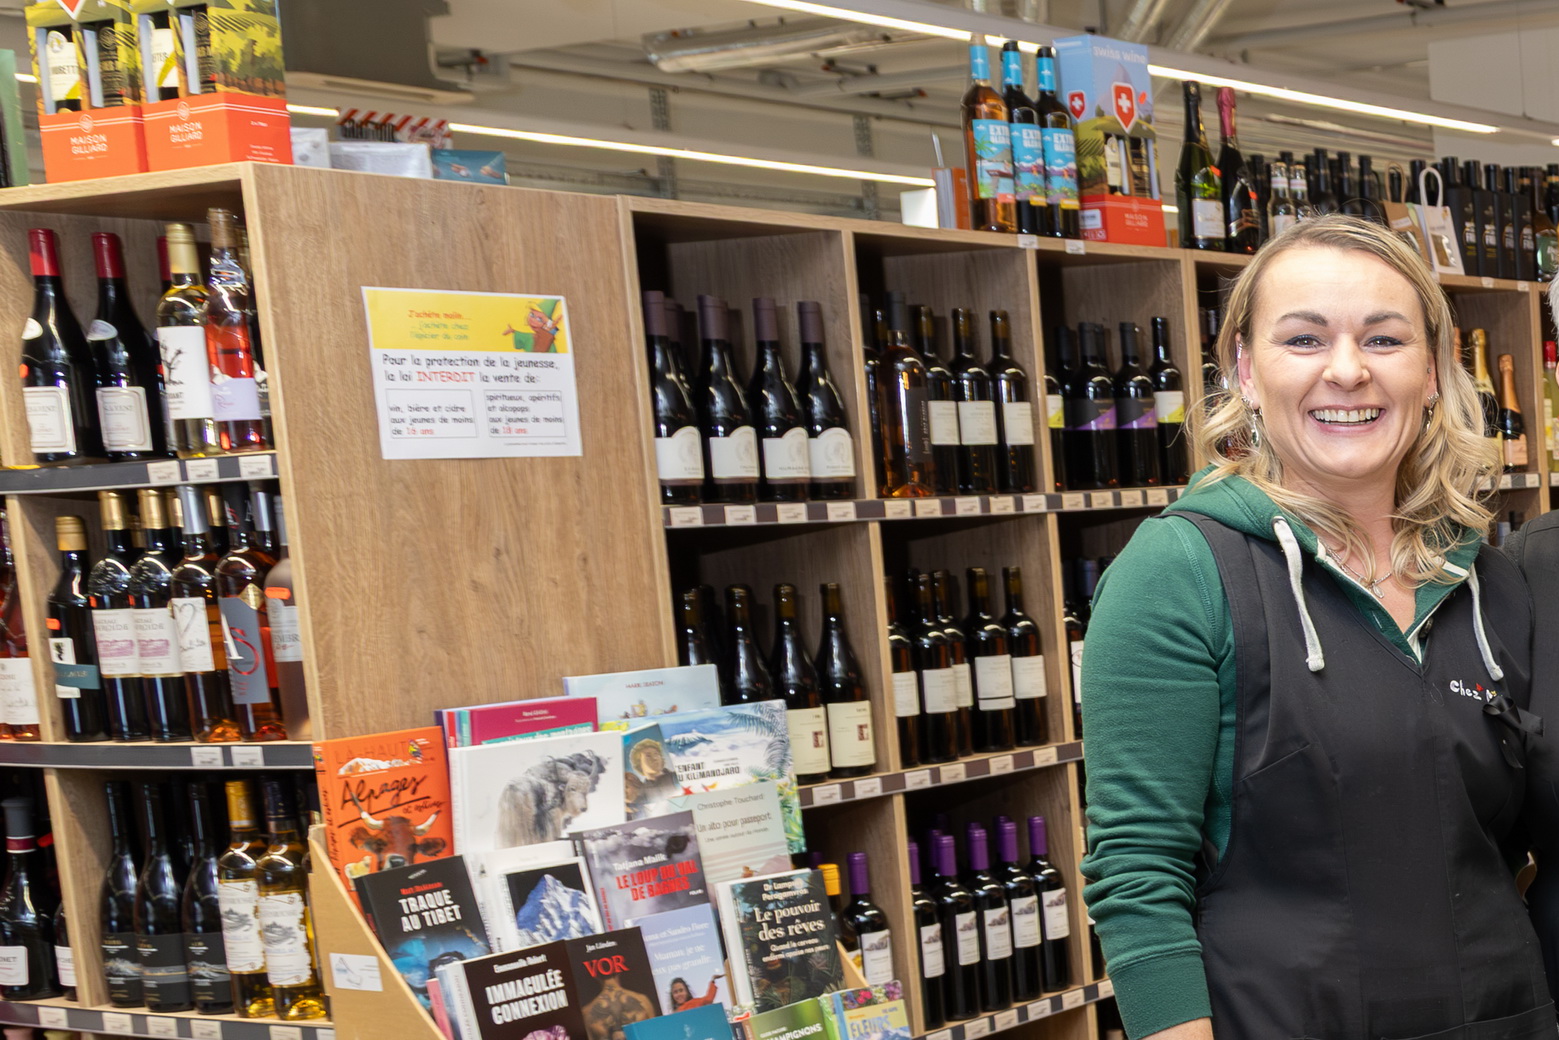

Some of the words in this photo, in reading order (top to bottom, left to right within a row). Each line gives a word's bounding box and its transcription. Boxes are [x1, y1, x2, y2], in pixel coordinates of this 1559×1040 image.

[1093, 45, 1120, 59] swiss
[1122, 50, 1145, 63] wine
[169, 121, 202, 133] MAISON
[70, 134, 107, 146] MAISON
[170, 131, 202, 143] GILLIARD
[71, 143, 108, 154] GILLIARD
[382, 354, 407, 366] Pour
[411, 354, 422, 366] la
[426, 355, 480, 369] protection
[483, 356, 496, 367] de
[500, 356, 510, 367] la
[514, 357, 560, 371] jeunesse,
[385, 370, 394, 381] la
[399, 370, 412, 381] loi
[416, 371, 475, 383] INTERDIT
[480, 371, 489, 382] la
[493, 372, 520, 384] vente
[389, 405, 403, 413] vin,
[407, 404, 430, 412] bière
[446, 404, 465, 413] cidre
[409, 416, 435, 426] jeunes
[439, 416, 448, 424] de
[452, 416, 473, 424] moins
[504, 416, 528, 426] jeunes
[543, 416, 563, 424] moins
[392, 427, 402, 435] de
[1450, 680, 1482, 700] Chez
[341, 774, 428, 814] Alpages
[697, 799, 732, 811] Christophe
[734, 793, 764, 804] Touchard
[697, 824, 707, 832] Un
[723, 819, 738, 830] pour
[741, 812, 772, 826] passeport
[613, 856, 643, 872] Tatjana
[643, 853, 667, 868] Malik
[616, 875, 629, 889] LE
[630, 869, 658, 886] LOUP
[659, 866, 675, 880] DU
[676, 860, 698, 876] VAL
[630, 886, 645, 901] DE
[647, 877, 690, 898] BAGNES
[762, 888, 809, 901] Perogamvros
[398, 889, 454, 915] TRAQUE
[401, 915, 422, 932] AU
[423, 905, 462, 926] TIBET
[754, 907, 773, 923] Le
[774, 900, 821, 924] pouvoir
[758, 925, 785, 941] des
[788, 918, 825, 937] rêves
[695, 944, 705, 953] ne
[770, 942, 790, 951] Quand
[797, 938, 819, 947] cerveau
[582, 954, 630, 978] VOR
[668, 964, 682, 974] pas
[485, 969, 566, 1005] IMMACULÉE
[491, 989, 569, 1025] CONNEXION
[850, 1015, 892, 1039] FLEURS
